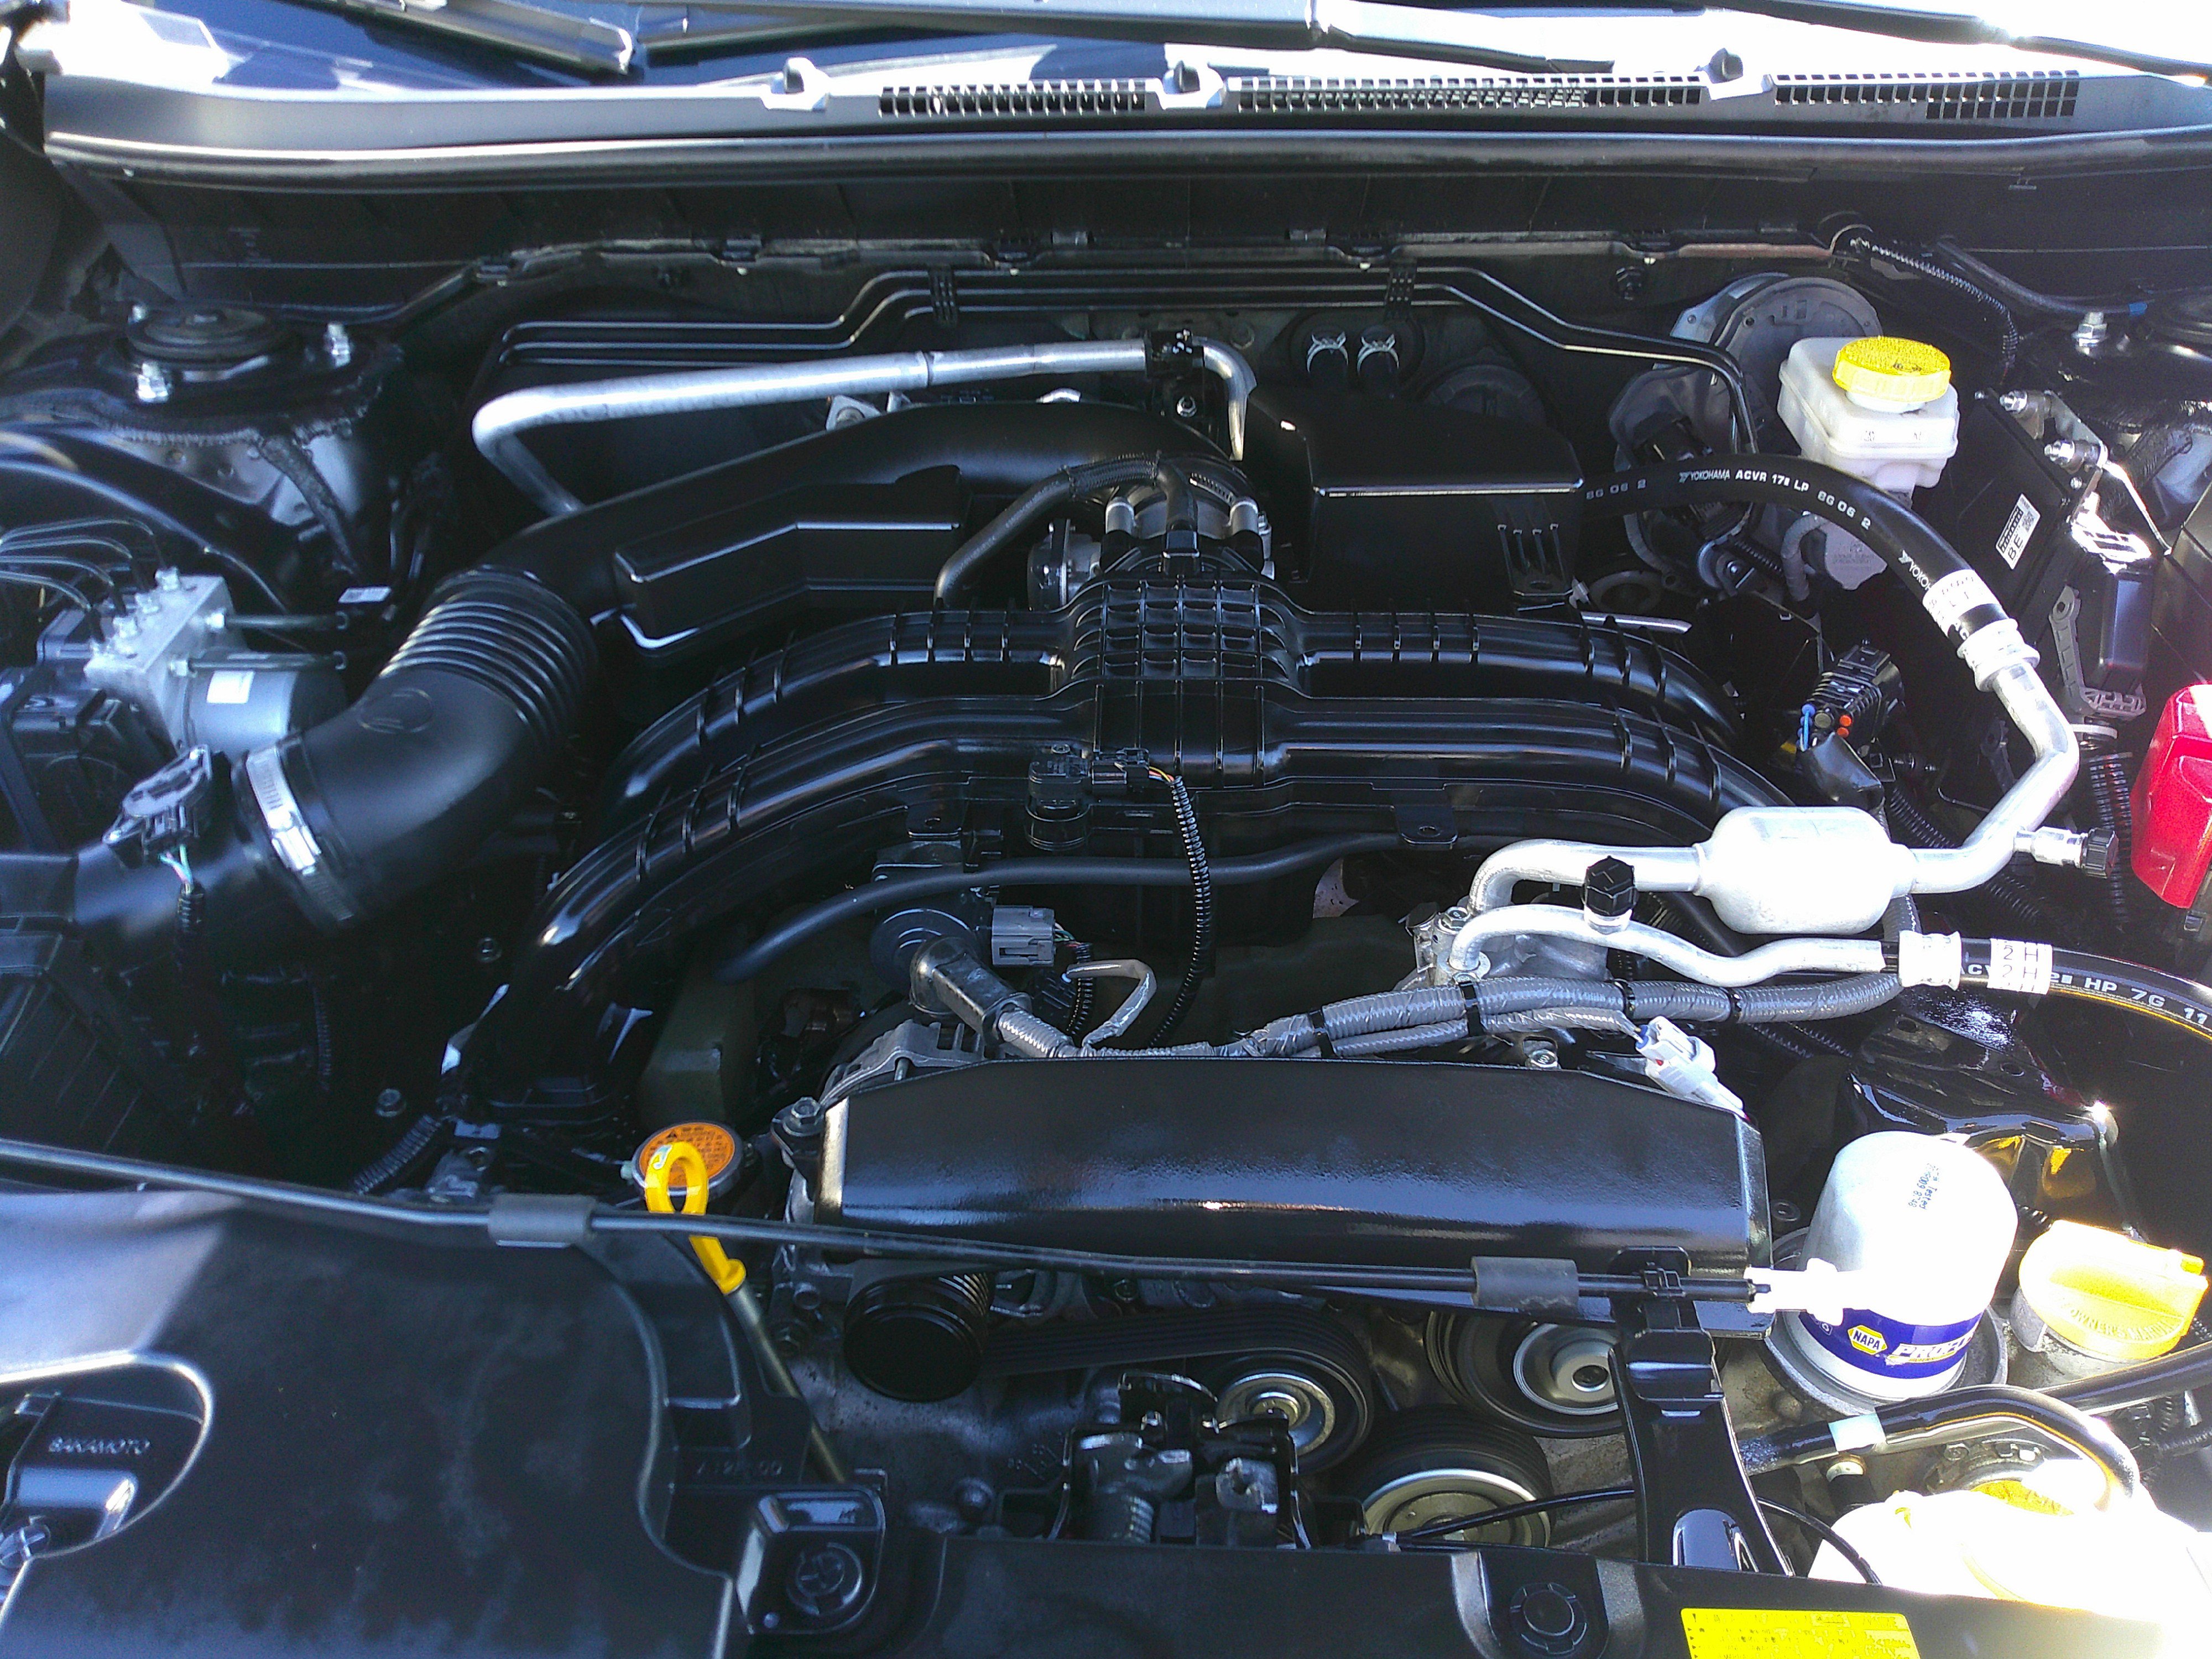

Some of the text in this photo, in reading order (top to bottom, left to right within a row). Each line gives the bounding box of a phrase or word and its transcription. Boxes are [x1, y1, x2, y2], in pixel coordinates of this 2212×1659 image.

[1689, 469, 1730, 481] YOKOHAMA
[1735, 469, 1767, 482] ACVR
[1793, 479, 1809, 492] LP
[1861, 517, 1871, 531] 2
[1908, 560, 1932, 591] YOKOH
[2084, 977, 2118, 993] HP
[2131, 988, 2166, 1007] 7G
[1853, 1330, 1881, 1350] NAPA
